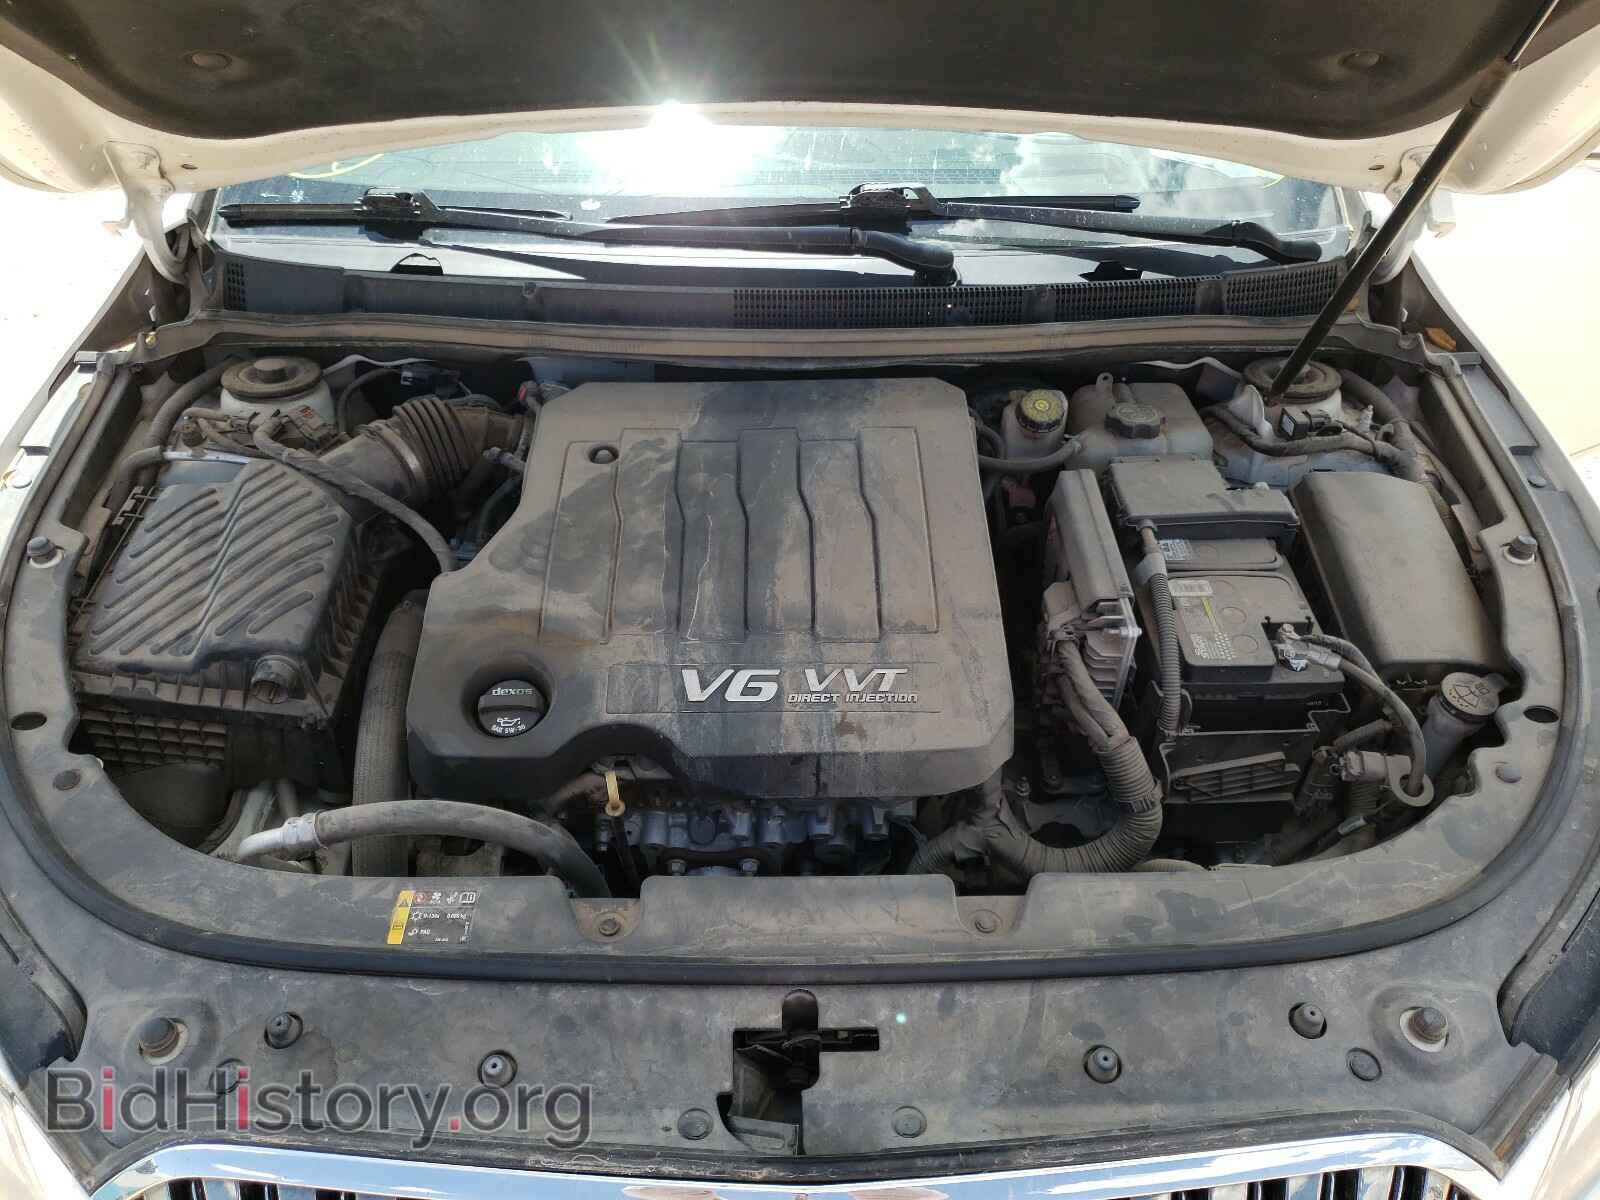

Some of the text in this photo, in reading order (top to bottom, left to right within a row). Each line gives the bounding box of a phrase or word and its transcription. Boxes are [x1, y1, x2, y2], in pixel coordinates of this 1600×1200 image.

[681, 668, 908, 702] V6 VVT
[492, 687, 535, 696] dexos
[787, 693, 918, 704] DIRECT INJECTION
